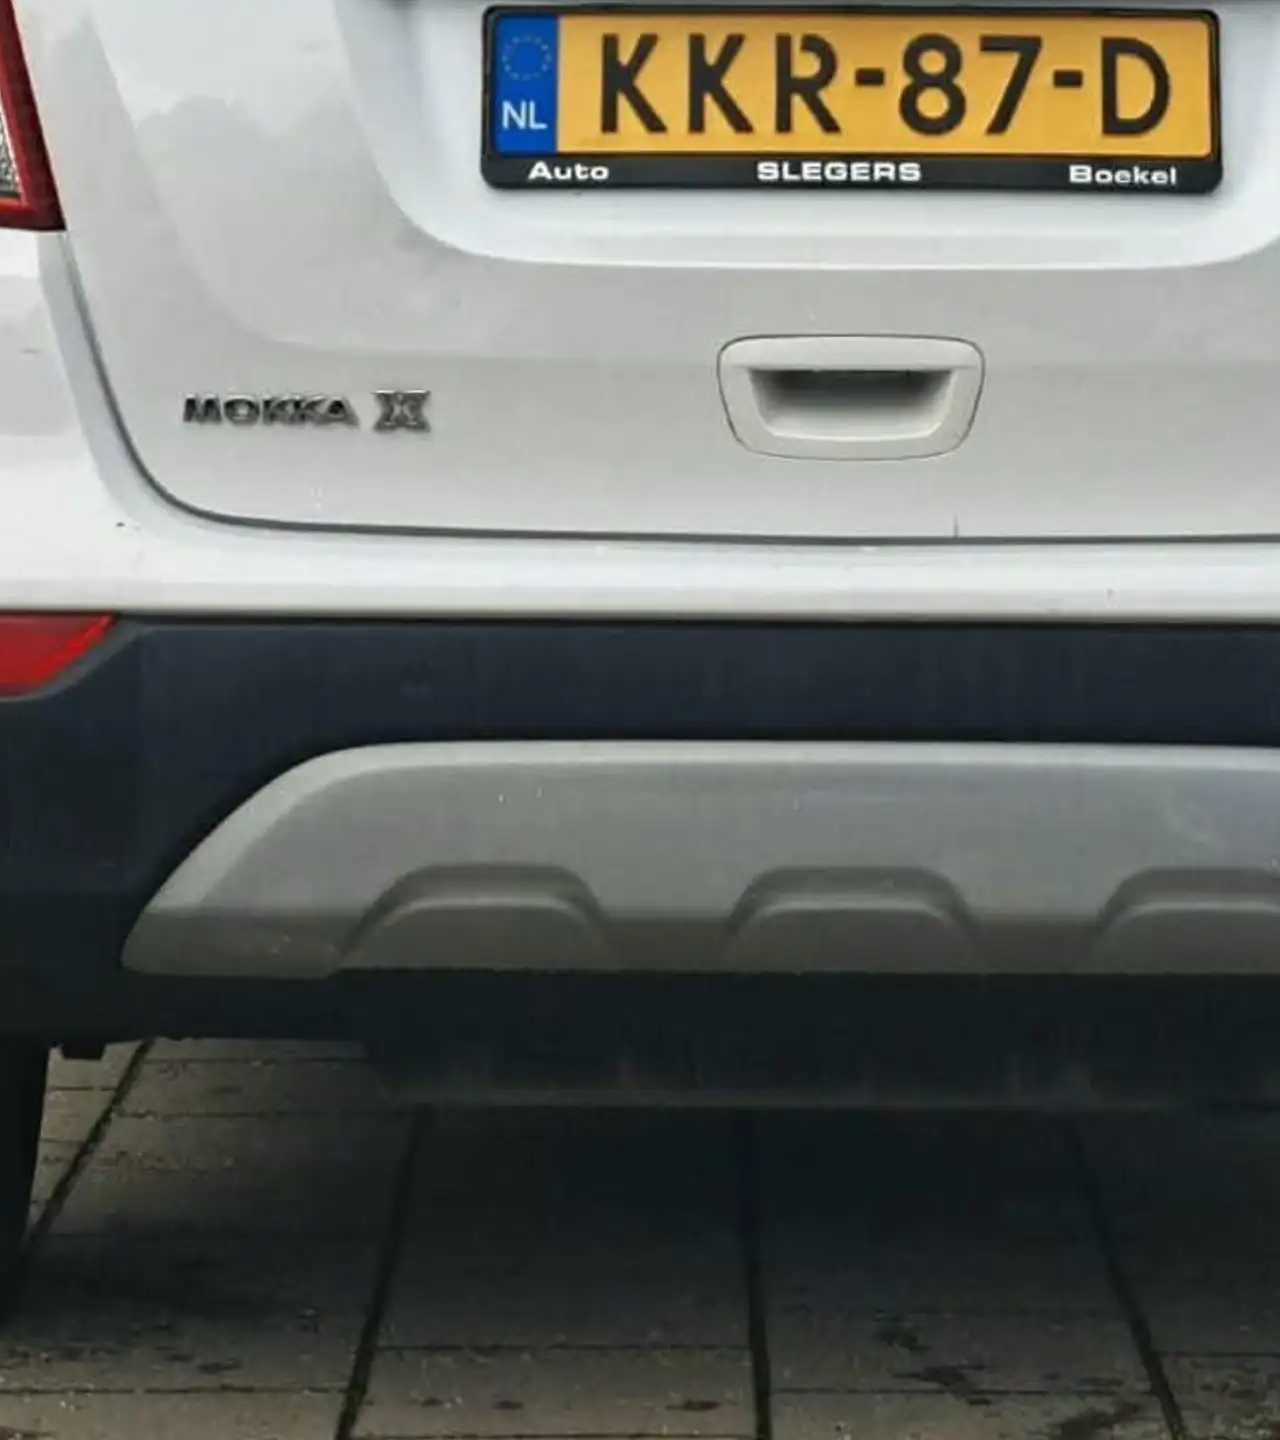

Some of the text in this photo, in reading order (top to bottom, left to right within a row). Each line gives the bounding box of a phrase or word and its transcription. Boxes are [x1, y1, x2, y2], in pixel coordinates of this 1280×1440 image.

[502, 33, 1170, 136] NL KKR-87-D
[528, 161, 1177, 185] Auto SLEGERS Boekel
[182, 389, 431, 433] MOKKA X
